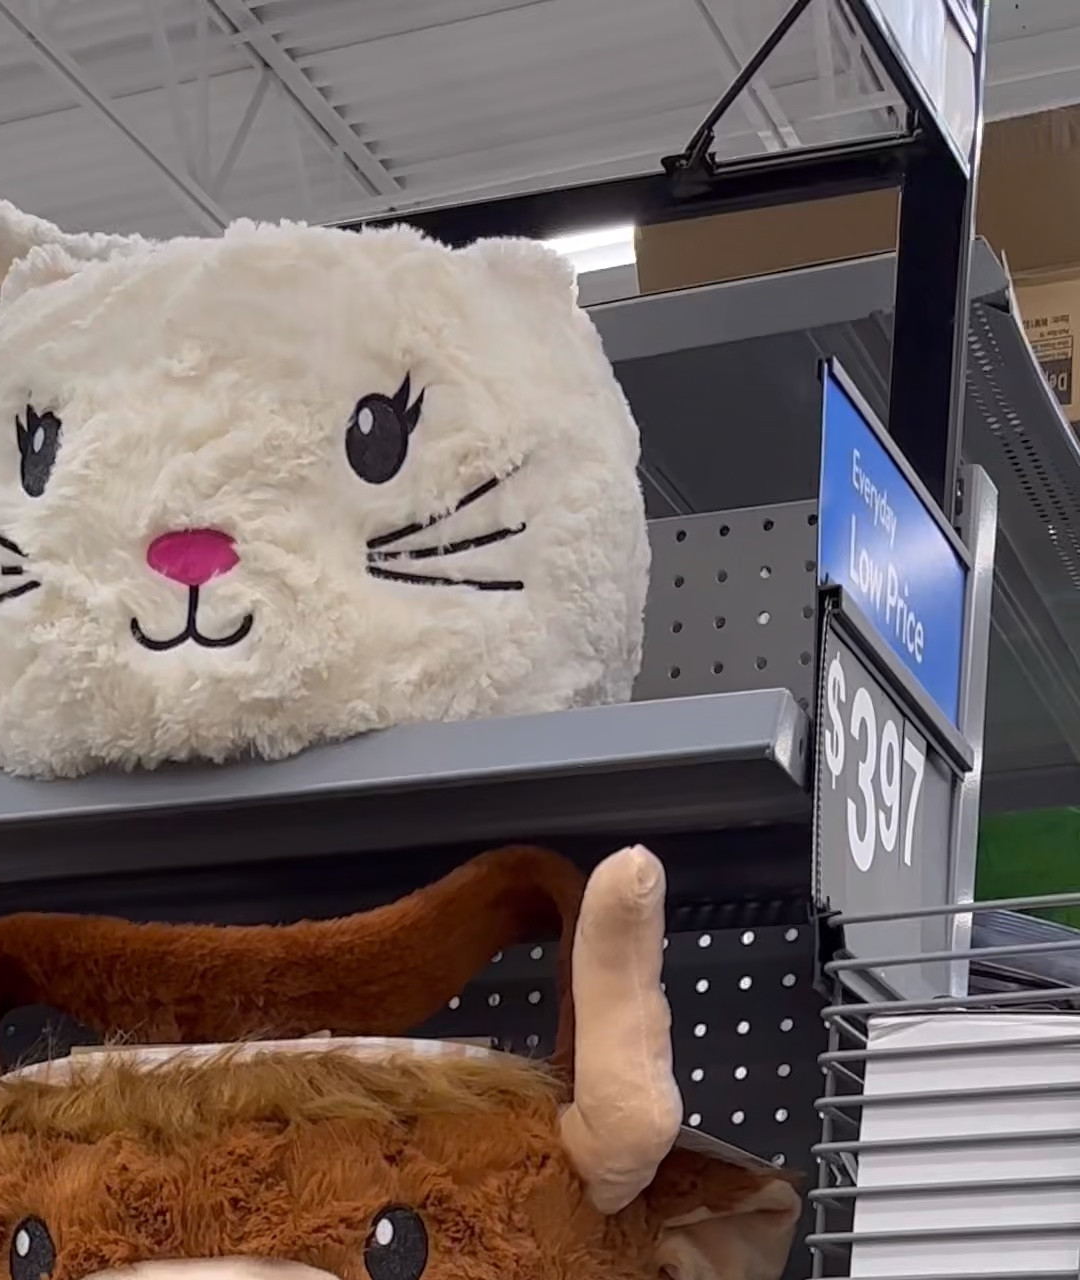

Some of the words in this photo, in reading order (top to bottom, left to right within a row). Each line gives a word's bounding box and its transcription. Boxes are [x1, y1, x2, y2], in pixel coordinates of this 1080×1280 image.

[851, 447, 898, 546] Everyday
[849, 513, 883, 609] Low
[885, 563, 924, 664] Price
